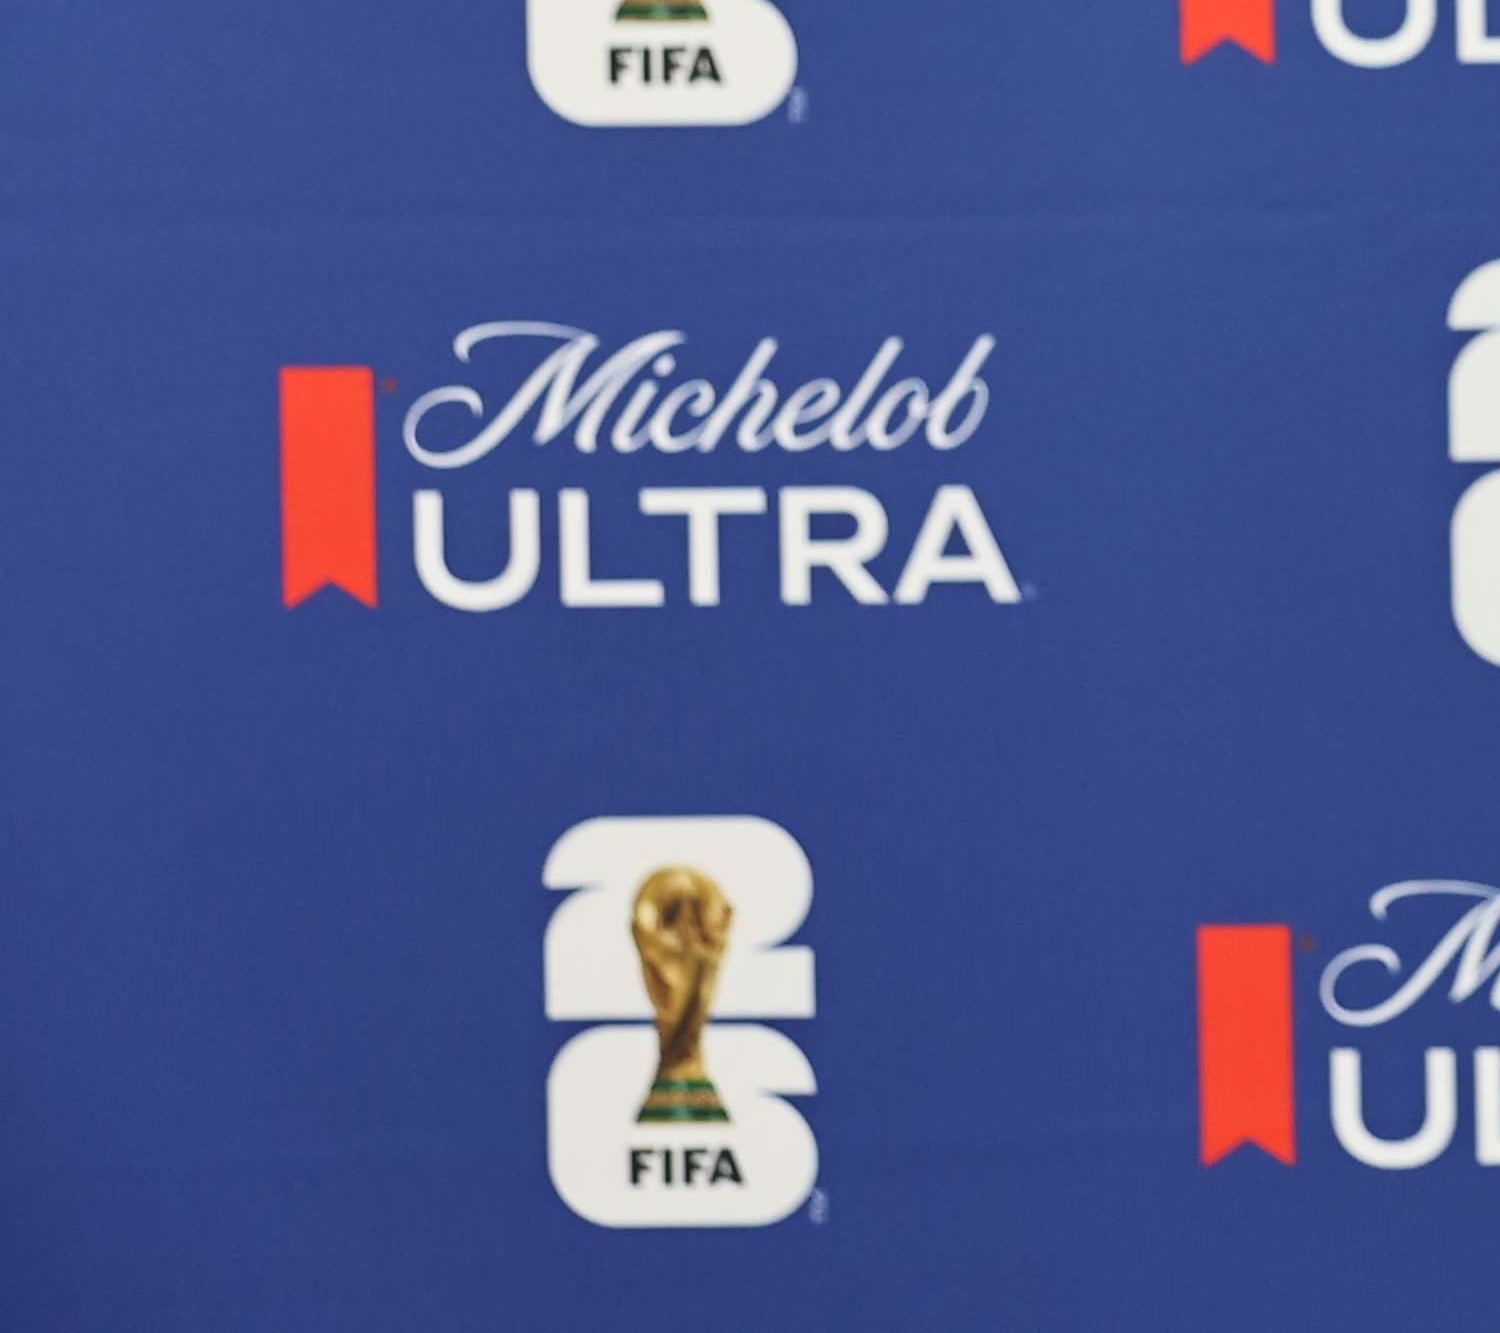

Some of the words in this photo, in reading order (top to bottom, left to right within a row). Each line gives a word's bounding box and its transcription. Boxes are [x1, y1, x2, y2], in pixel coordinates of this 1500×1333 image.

[610, 48, 720, 83] FIFA
[405, 323, 993, 467] Michelob
[414, 486, 1020, 611] ULTRA
[631, 1149, 742, 1185] FIFA
